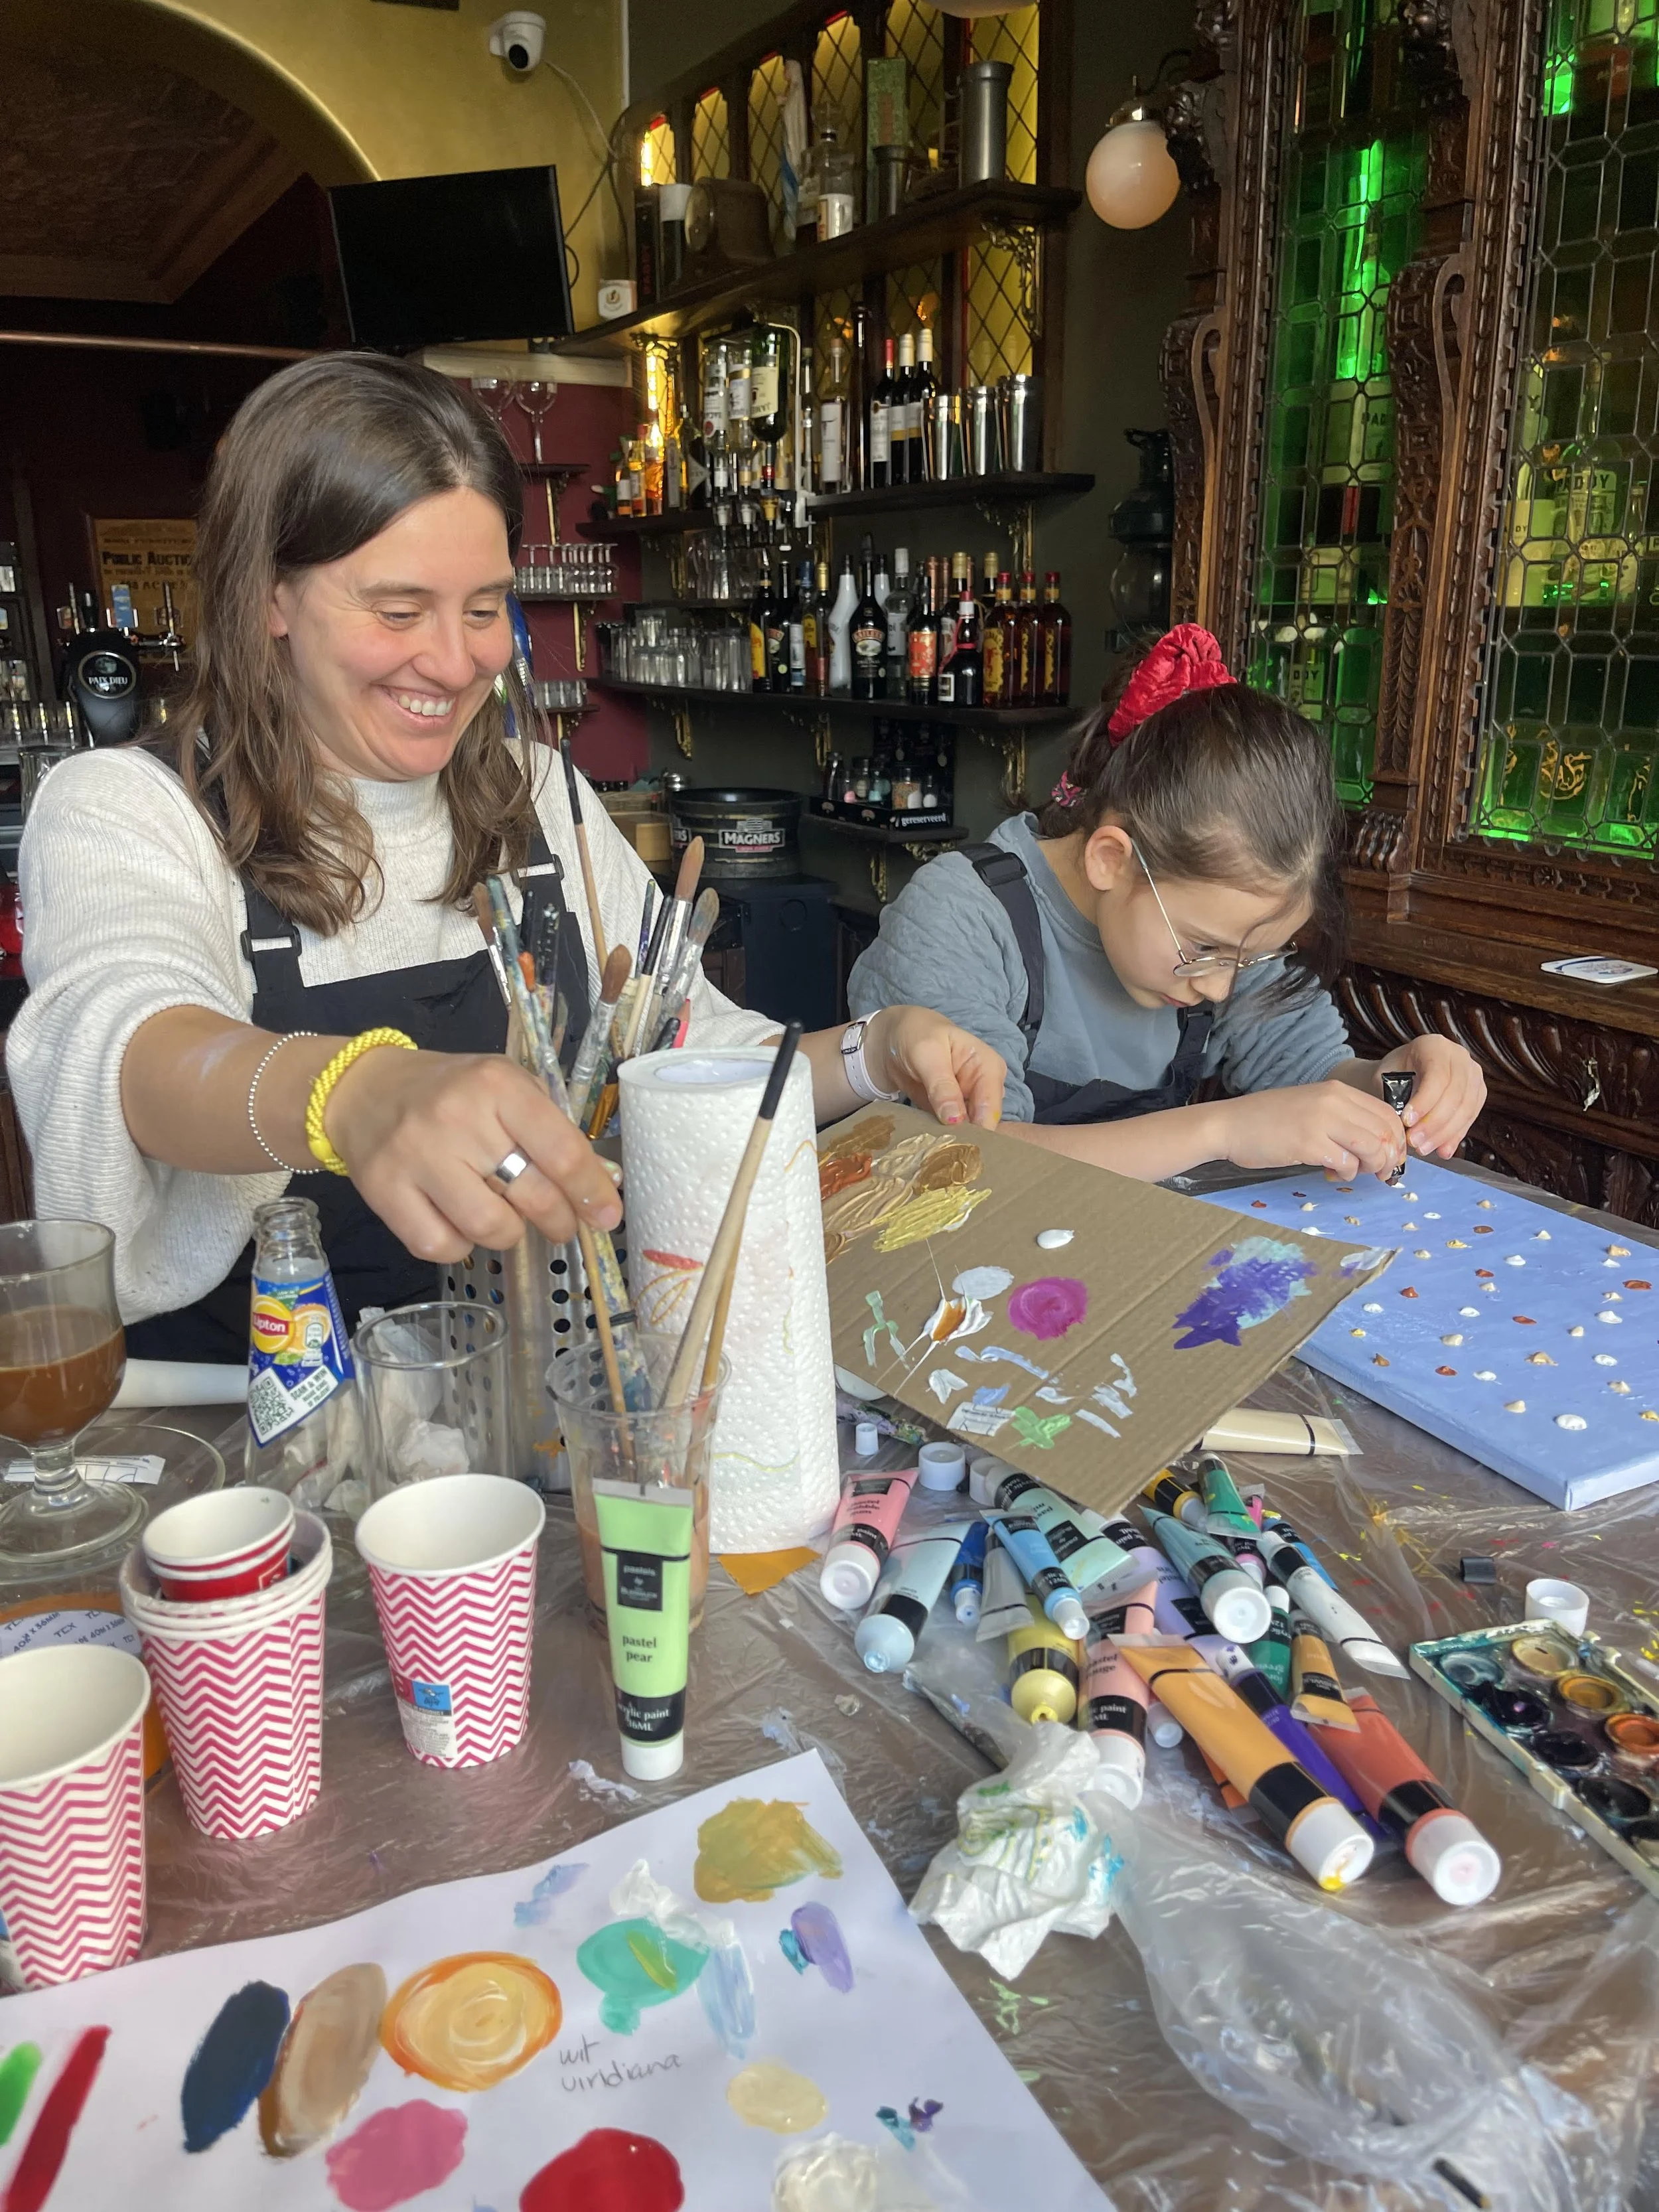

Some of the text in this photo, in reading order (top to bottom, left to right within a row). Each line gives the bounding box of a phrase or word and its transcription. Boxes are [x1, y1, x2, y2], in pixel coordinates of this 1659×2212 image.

[88, 676, 129, 685] PAIX DIEU
[901, 812, 946, 827] gereserveerd
[724, 832, 781, 845] MAGNERS
[253, 1314, 286, 1333] Lipton
[622, 1635, 657, 1649] pastel
[626, 1651, 653, 1662] pear
[644, 1708, 670, 1721] paint
